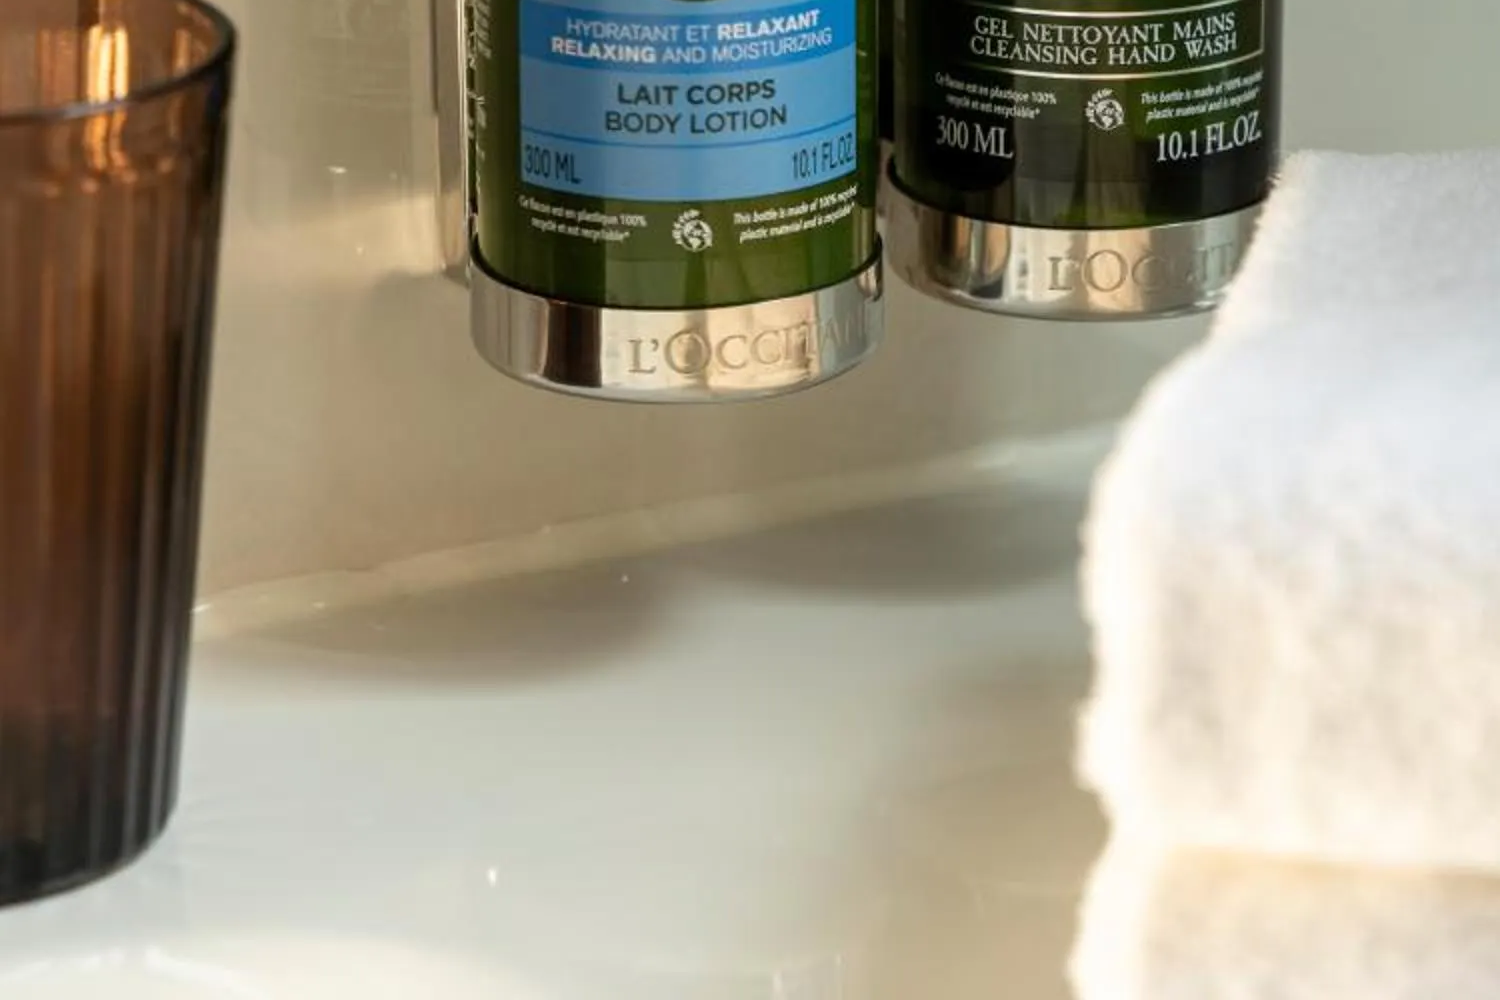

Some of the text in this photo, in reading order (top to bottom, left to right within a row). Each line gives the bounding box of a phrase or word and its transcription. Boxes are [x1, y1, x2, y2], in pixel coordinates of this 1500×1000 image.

[566, 9, 820, 43] HYDRATANT ET RELAXANT
[974, 11, 1236, 45] GEL NETTOYANT MAINS
[551, 27, 832, 64] RELAXING AND MOISTURIZING
[969, 32, 1238, 65] CLEANSING HAND WASH
[618, 79, 776, 105] LAIT CORPS
[605, 104, 787, 134] BODY LOTION
[936, 115, 1014, 159] 300 ML
[1157, 129, 1199, 161] 10.1
[525, 144, 583, 185] 300 ML
[792, 146, 817, 181] 10.1
